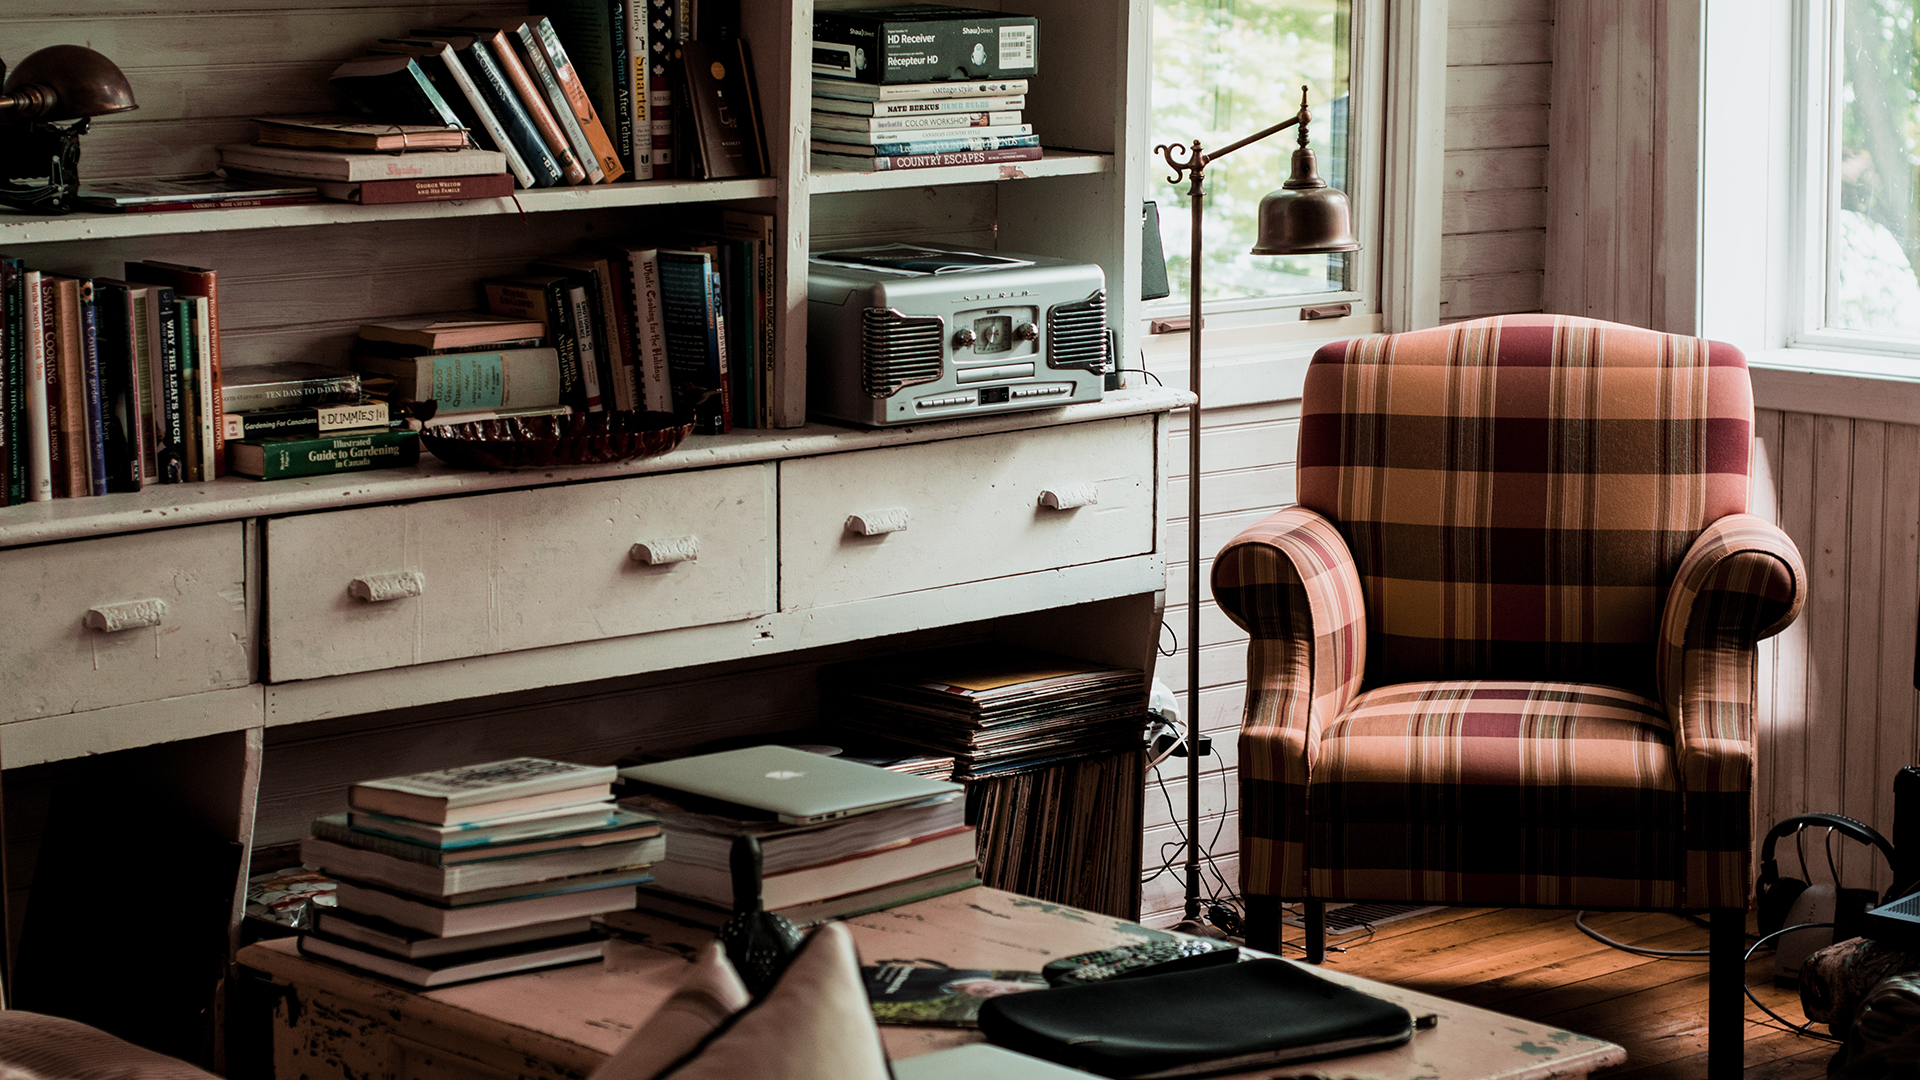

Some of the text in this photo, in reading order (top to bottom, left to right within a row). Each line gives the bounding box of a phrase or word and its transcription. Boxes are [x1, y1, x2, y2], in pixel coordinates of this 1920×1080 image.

[632, 1, 640, 32] Hurley
[962, 26, 977, 35] Shaw
[887, 33, 936, 44] HD Receiver
[476, 50, 507, 101] COMPASS
[887, 55, 939, 68] Récepteur HD
[613, 3, 631, 157] Marina Nemat After Tehran
[635, 56, 647, 121] Smarter
[932, 83, 973, 95] cottage style
[538, 58, 555, 90] Water
[554, 93, 570, 122] Dianne
[567, 120, 583, 149] Warren
[887, 105, 908, 113] NATE
[909, 103, 940, 112] BERKUS
[905, 119, 928, 128] COLOR
[930, 117, 968, 126] WORKSHOP
[897, 151, 985, 168] COUNTRY ESCAPES
[208, 283, 216, 297] The
[643, 261, 651, 288] What's
[575, 301, 591, 339] EMOTIONAL INTELLIGENCE
[647, 290, 657, 323] Cooking
[766, 306, 774, 328] BASIC
[167, 319, 176, 345] WHY
[210, 329, 218, 366] Character
[581, 341, 593, 352] 2.0
[651, 334, 660, 347] the
[718, 320, 727, 369] HOODWINKED
[86, 325, 98, 379] Country
[168, 348, 177, 371] THE
[557, 333, 573, 393] AND GLIMPSES
[566, 337, 578, 382] MEMORIES
[653, 347, 663, 383] Holidays
[766, 329, 774, 372] GARDENING
[9, 347, 17, 386] UNUSUAL
[42, 285, 59, 462] SMART COOKING ANNE LINDSAY
[88, 378, 98, 404] garden
[170, 374, 180, 411] LEAFS
[265, 390, 282, 399] TEN
[282, 388, 302, 398] DAYS
[303, 387, 315, 396] TO
[316, 385, 340, 394] D-DAY
[434, 368, 443, 401] 10,000
[444, 366, 453, 403] Garden
[453, 359, 461, 408] Questions
[10, 389, 18, 421] THINGS
[98, 361, 111, 441] The Road Well Kept
[212, 389, 220, 415] DAVID
[172, 412, 181, 445] SUCK
[244, 421, 276, 430] Gardening
[286, 418, 317, 427] Canadians
[327, 410, 374, 425] DUMMIES
[214, 417, 222, 450] BROOKS
[333, 437, 372, 449] Illustrated
[307, 444, 400, 462] Guide to Gardening
[335, 457, 371, 468] in Canada
